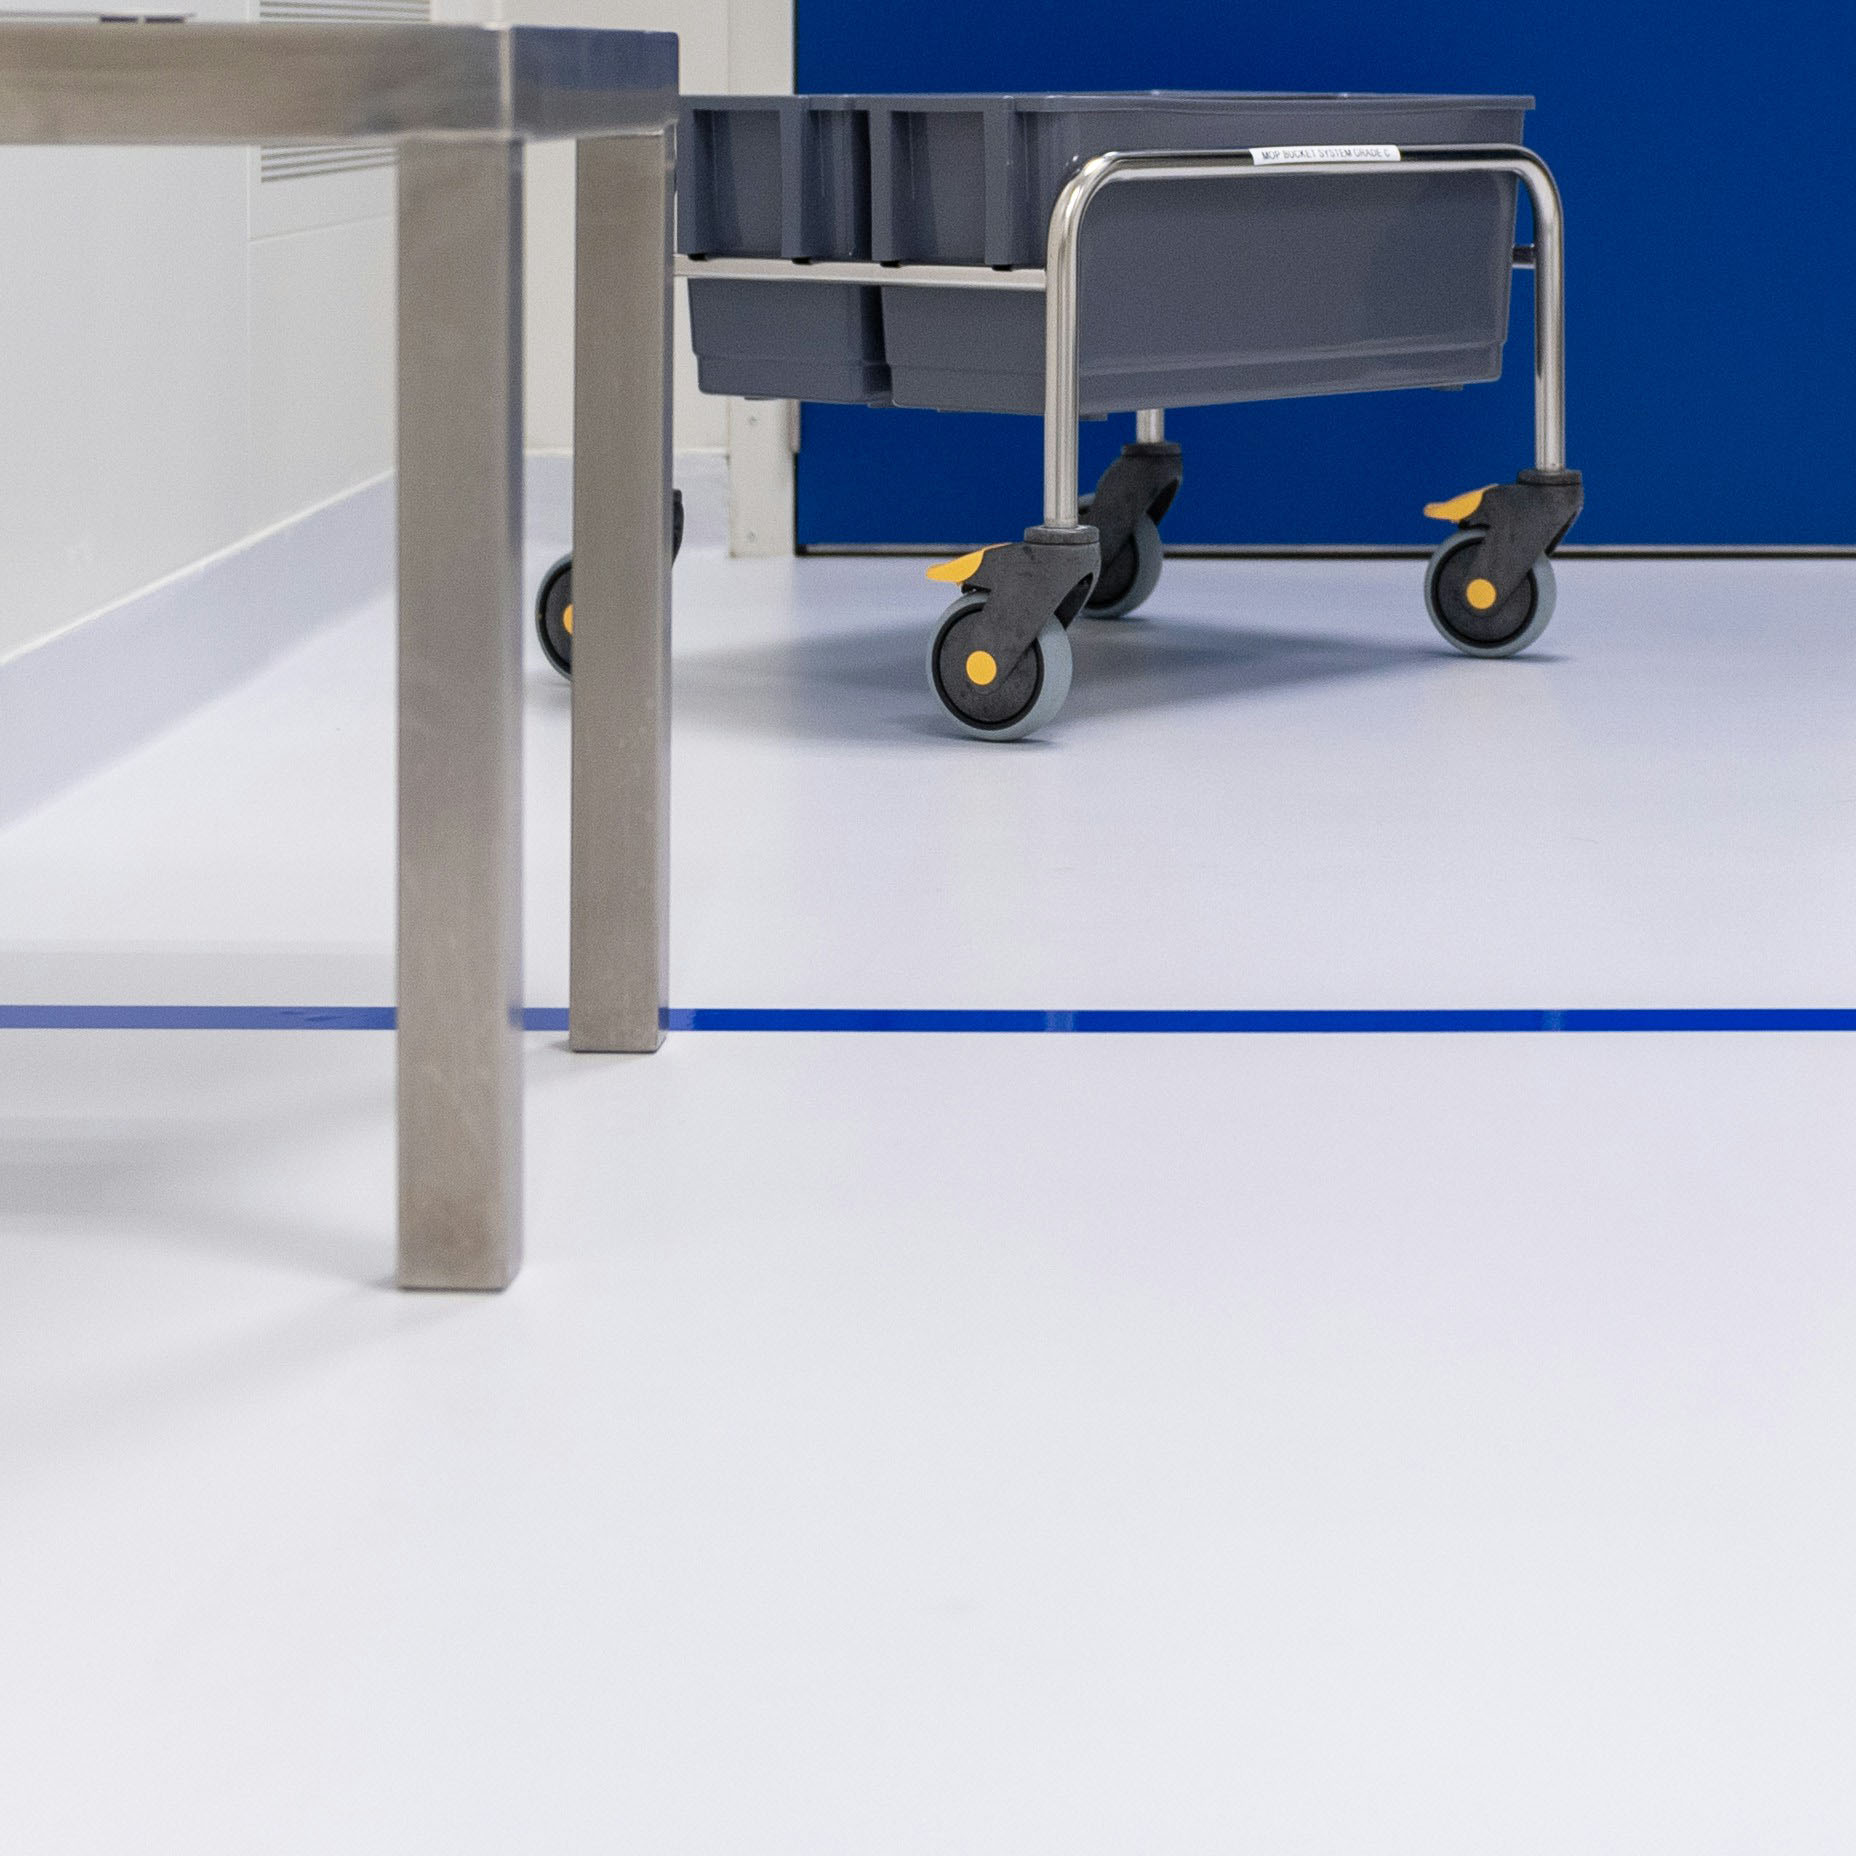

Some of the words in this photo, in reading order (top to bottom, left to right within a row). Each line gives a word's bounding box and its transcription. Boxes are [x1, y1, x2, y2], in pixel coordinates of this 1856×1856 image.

[1262, 151, 1280, 160] MOP
[1284, 149, 1316, 159] BUCKET
[1319, 148, 1352, 159] SYSTEM
[1354, 148, 1383, 158] GRADE
